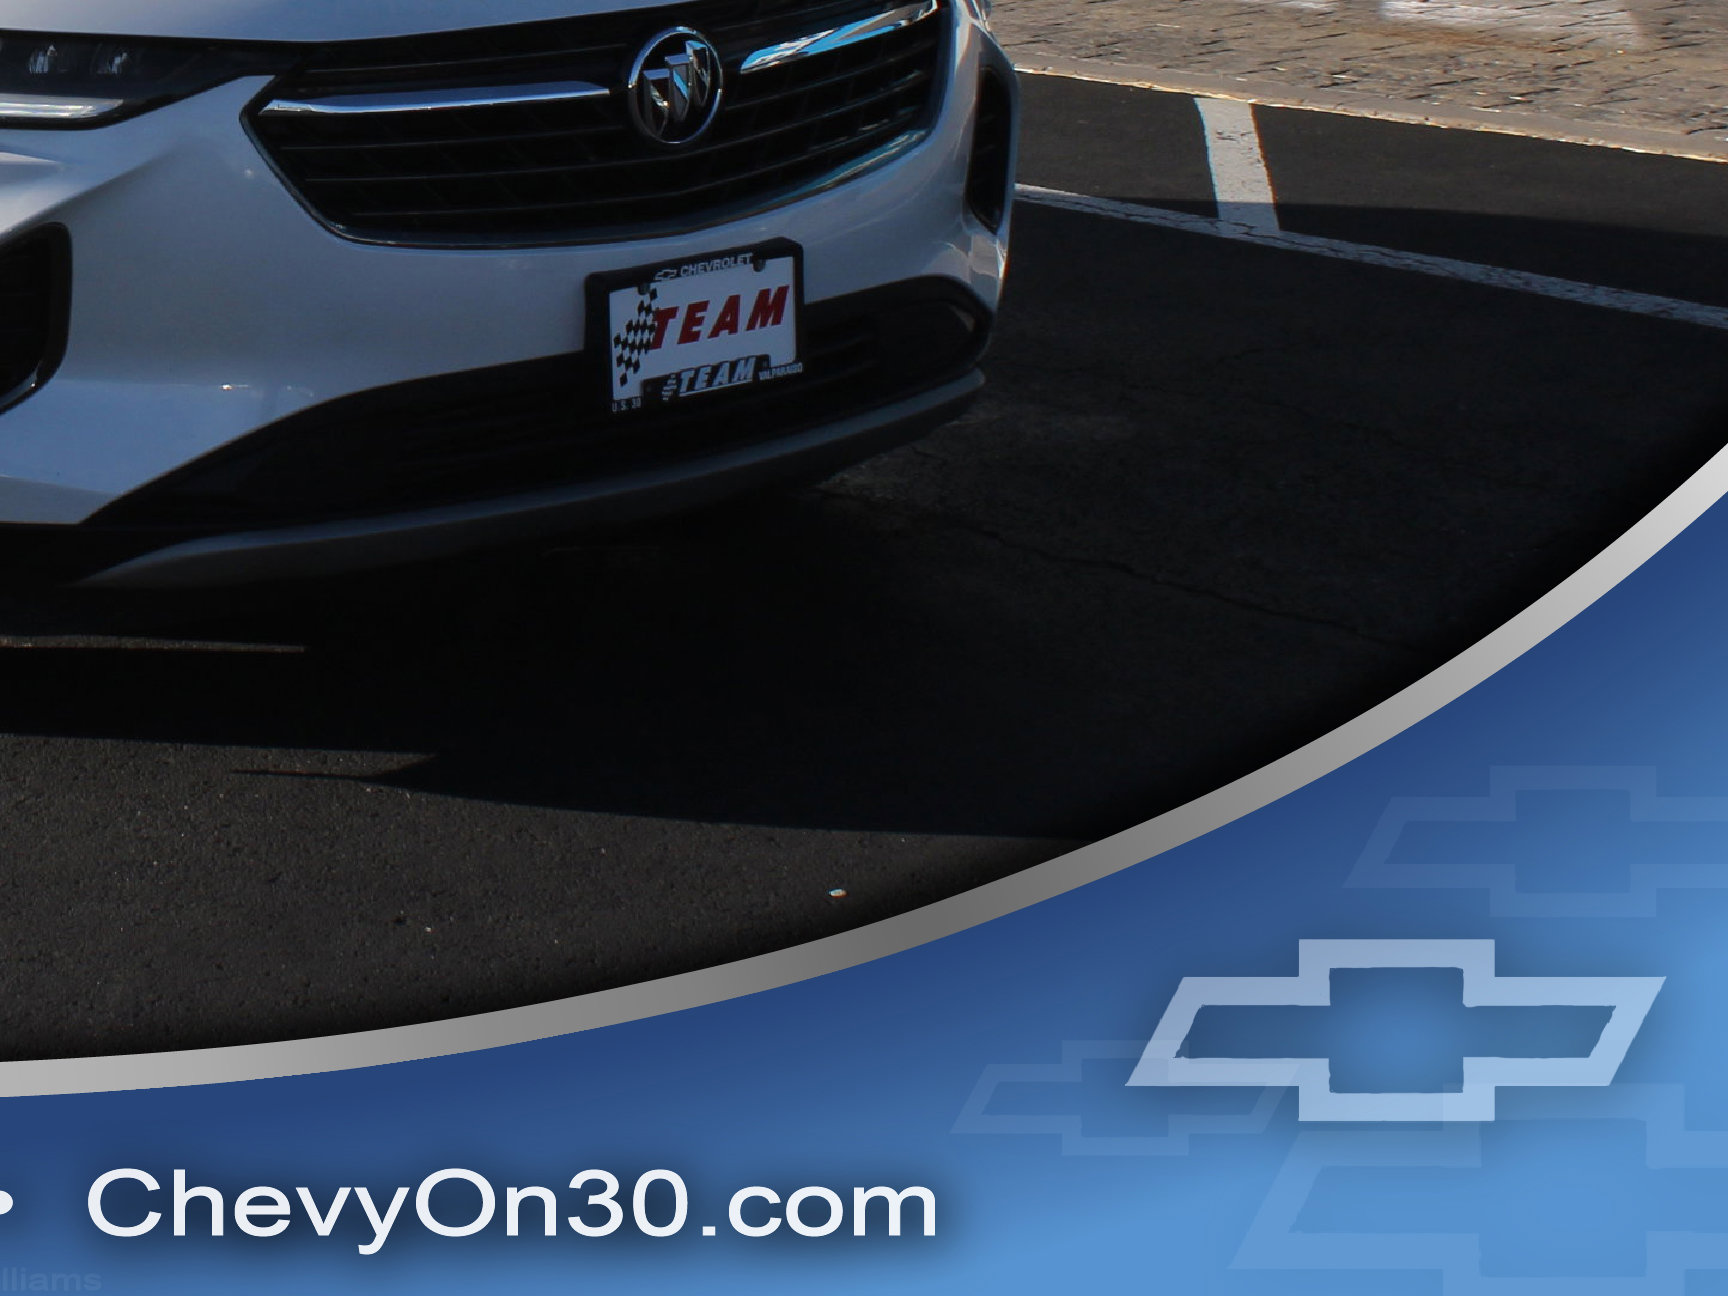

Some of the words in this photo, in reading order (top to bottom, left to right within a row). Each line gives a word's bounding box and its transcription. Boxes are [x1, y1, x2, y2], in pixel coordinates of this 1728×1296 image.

[680, 252, 754, 279] CHEVROLET
[649, 285, 790, 351] TEAM
[678, 355, 757, 394] TEAM
